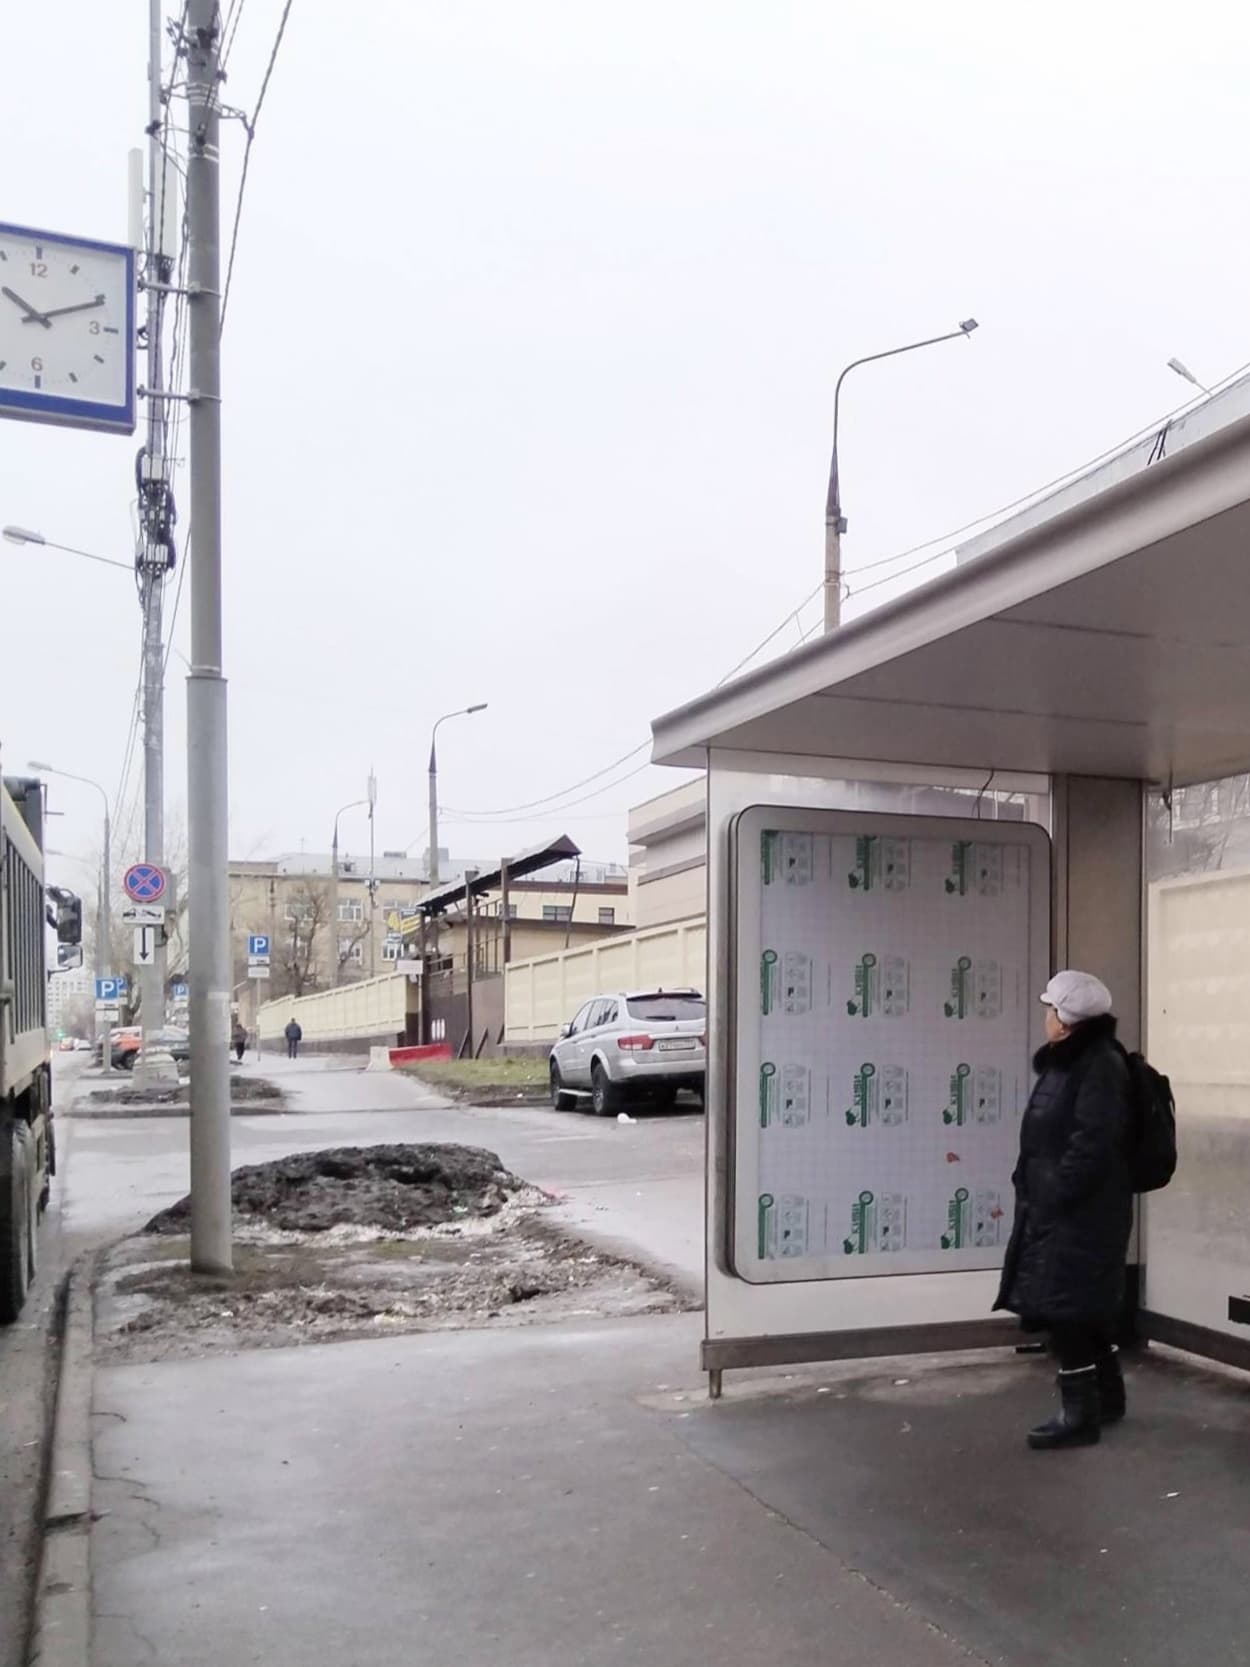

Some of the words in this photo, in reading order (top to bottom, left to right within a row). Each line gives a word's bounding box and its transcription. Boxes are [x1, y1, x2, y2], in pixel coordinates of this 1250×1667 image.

[30, 262, 48, 278] 12
[89, 320, 100, 335] 3
[31, 356, 43, 371] 6
[253, 937, 266, 953] P
[101, 981, 114, 997] P
